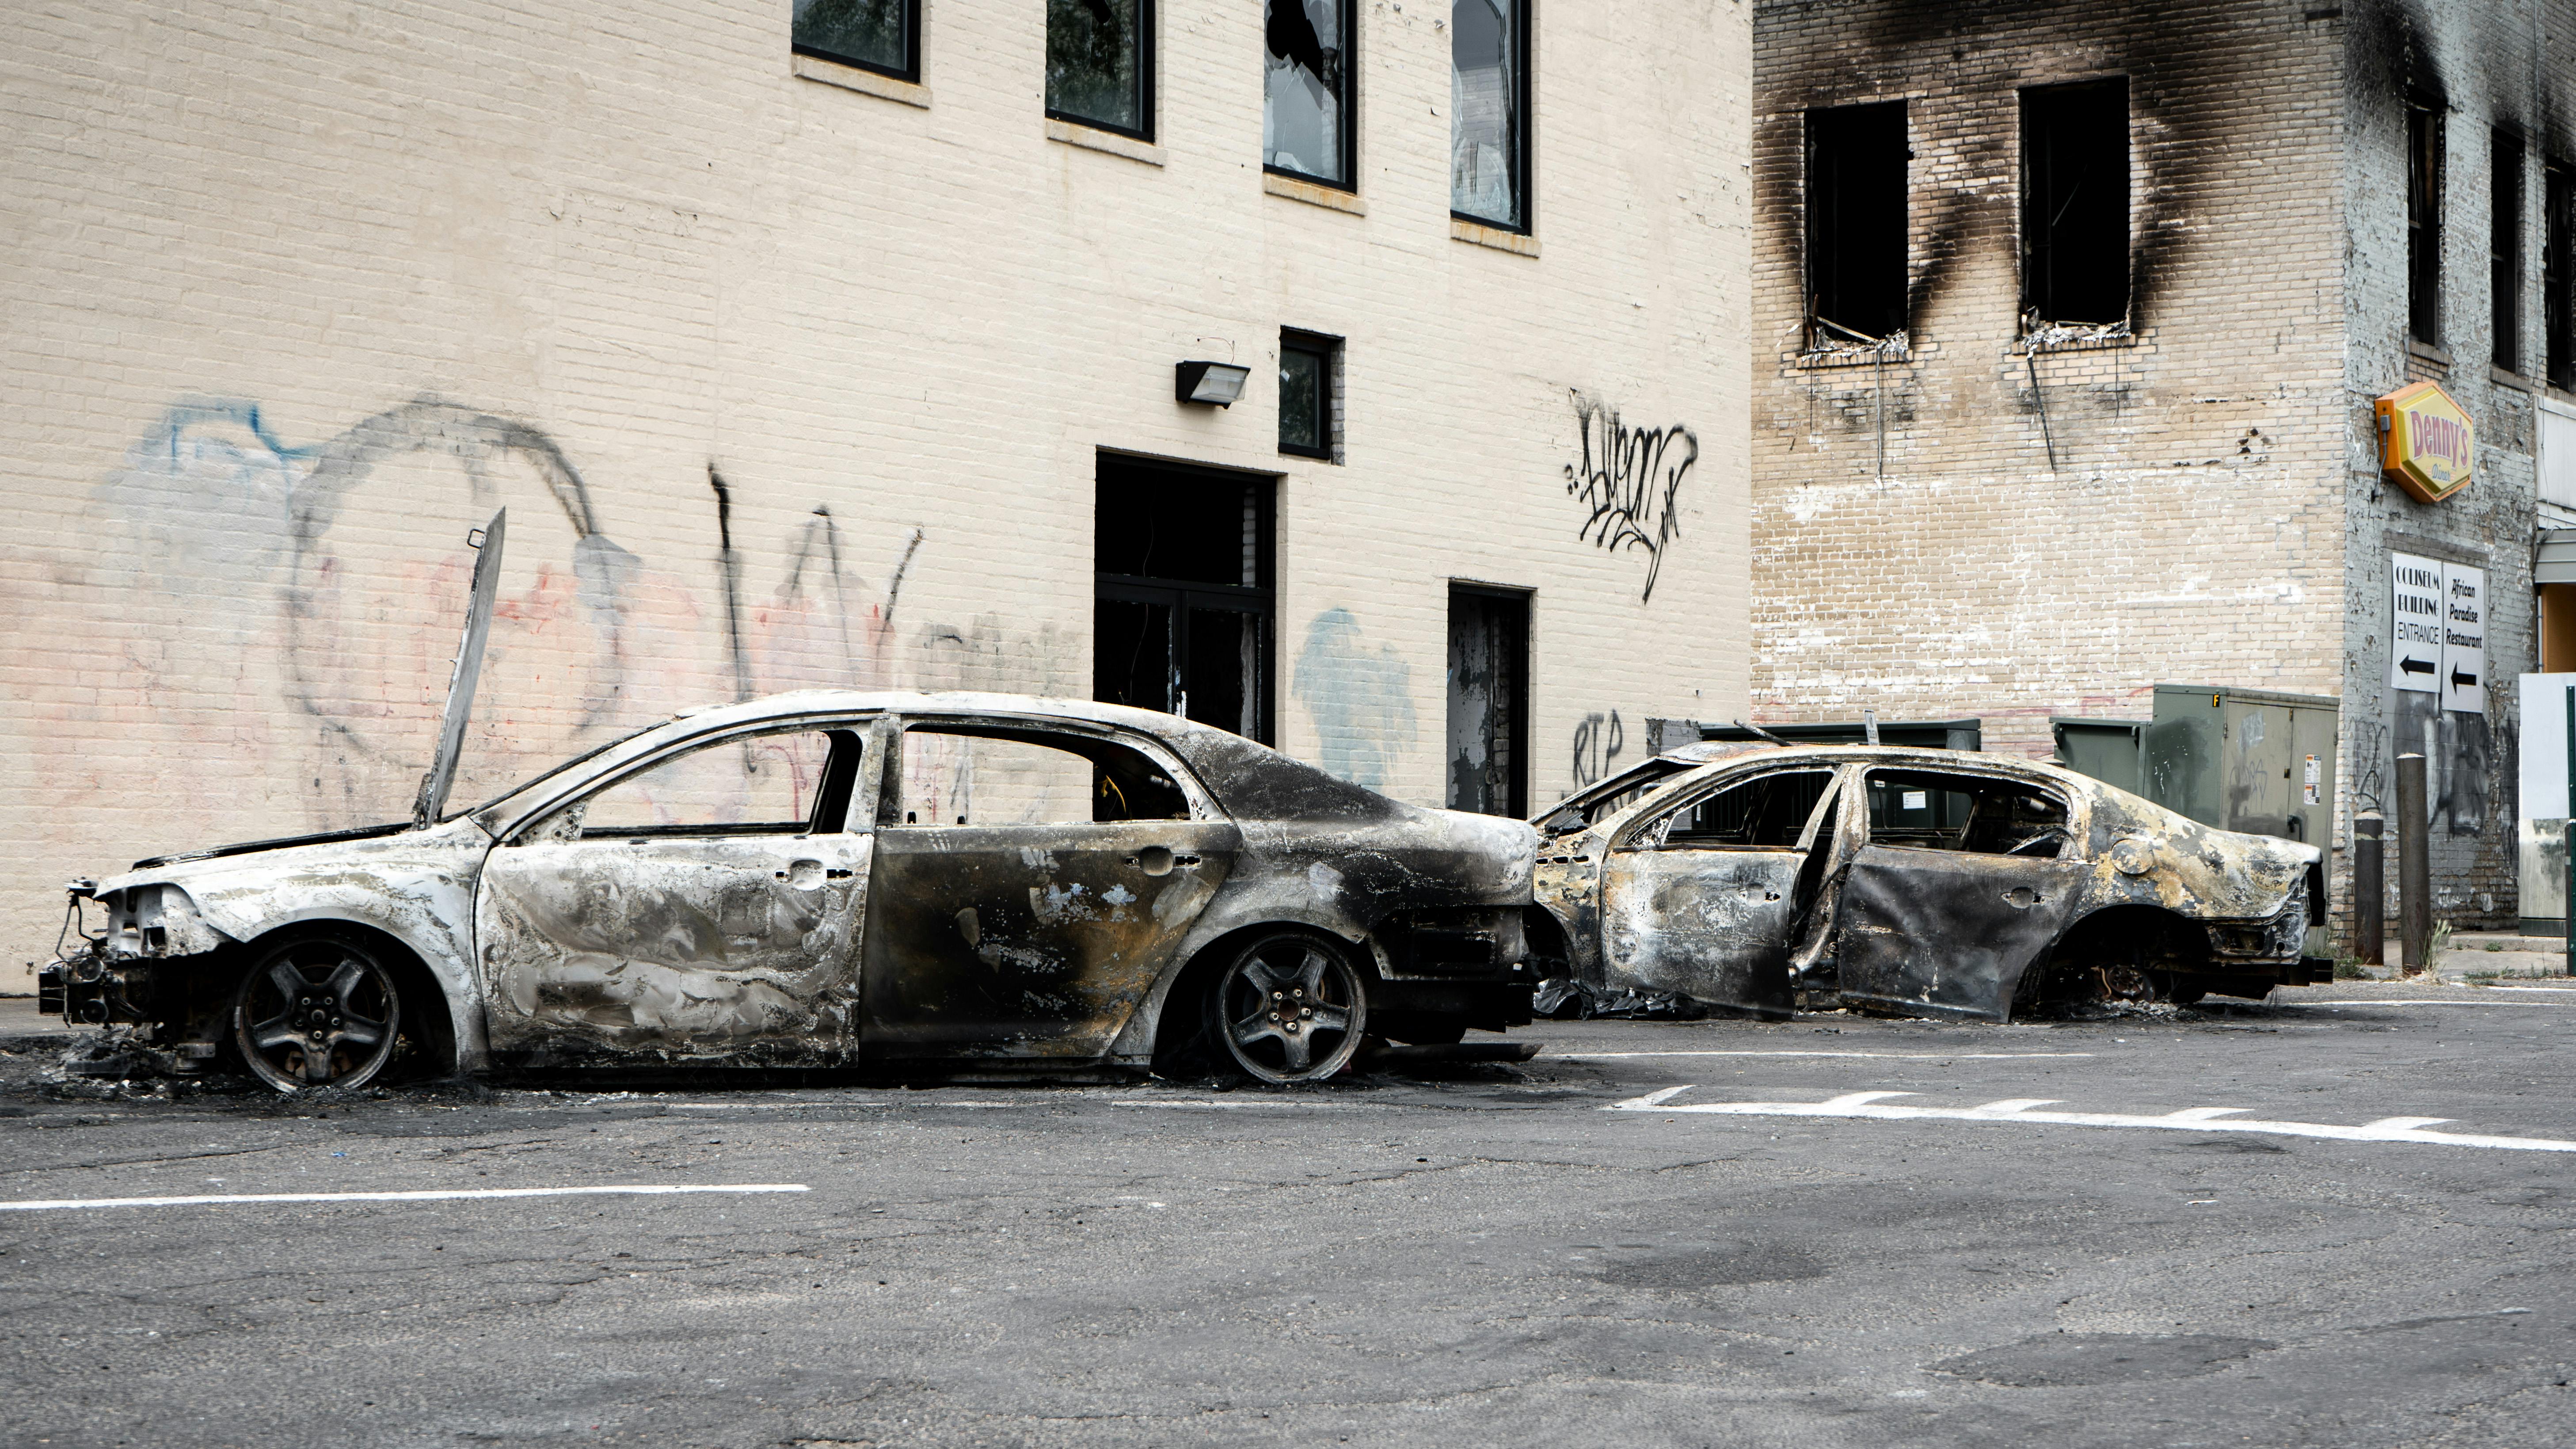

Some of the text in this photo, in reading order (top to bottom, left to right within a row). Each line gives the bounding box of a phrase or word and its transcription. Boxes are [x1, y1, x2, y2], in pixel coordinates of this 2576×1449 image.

[2410, 410, 2468, 469] Denny's
[2432, 463, 2450, 481] Diner
[2396, 566, 2439, 590] COLISEUM
[2451, 579, 2475, 599] African
[2398, 594, 2439, 617] BUILDING
[2450, 603, 2478, 623] Paradise
[2398, 622, 2439, 644] ENTRANCE
[2446, 628, 2482, 648] Restaurant
[2214, 694, 2219, 707] F
[1573, 709, 1623, 792] RIP
